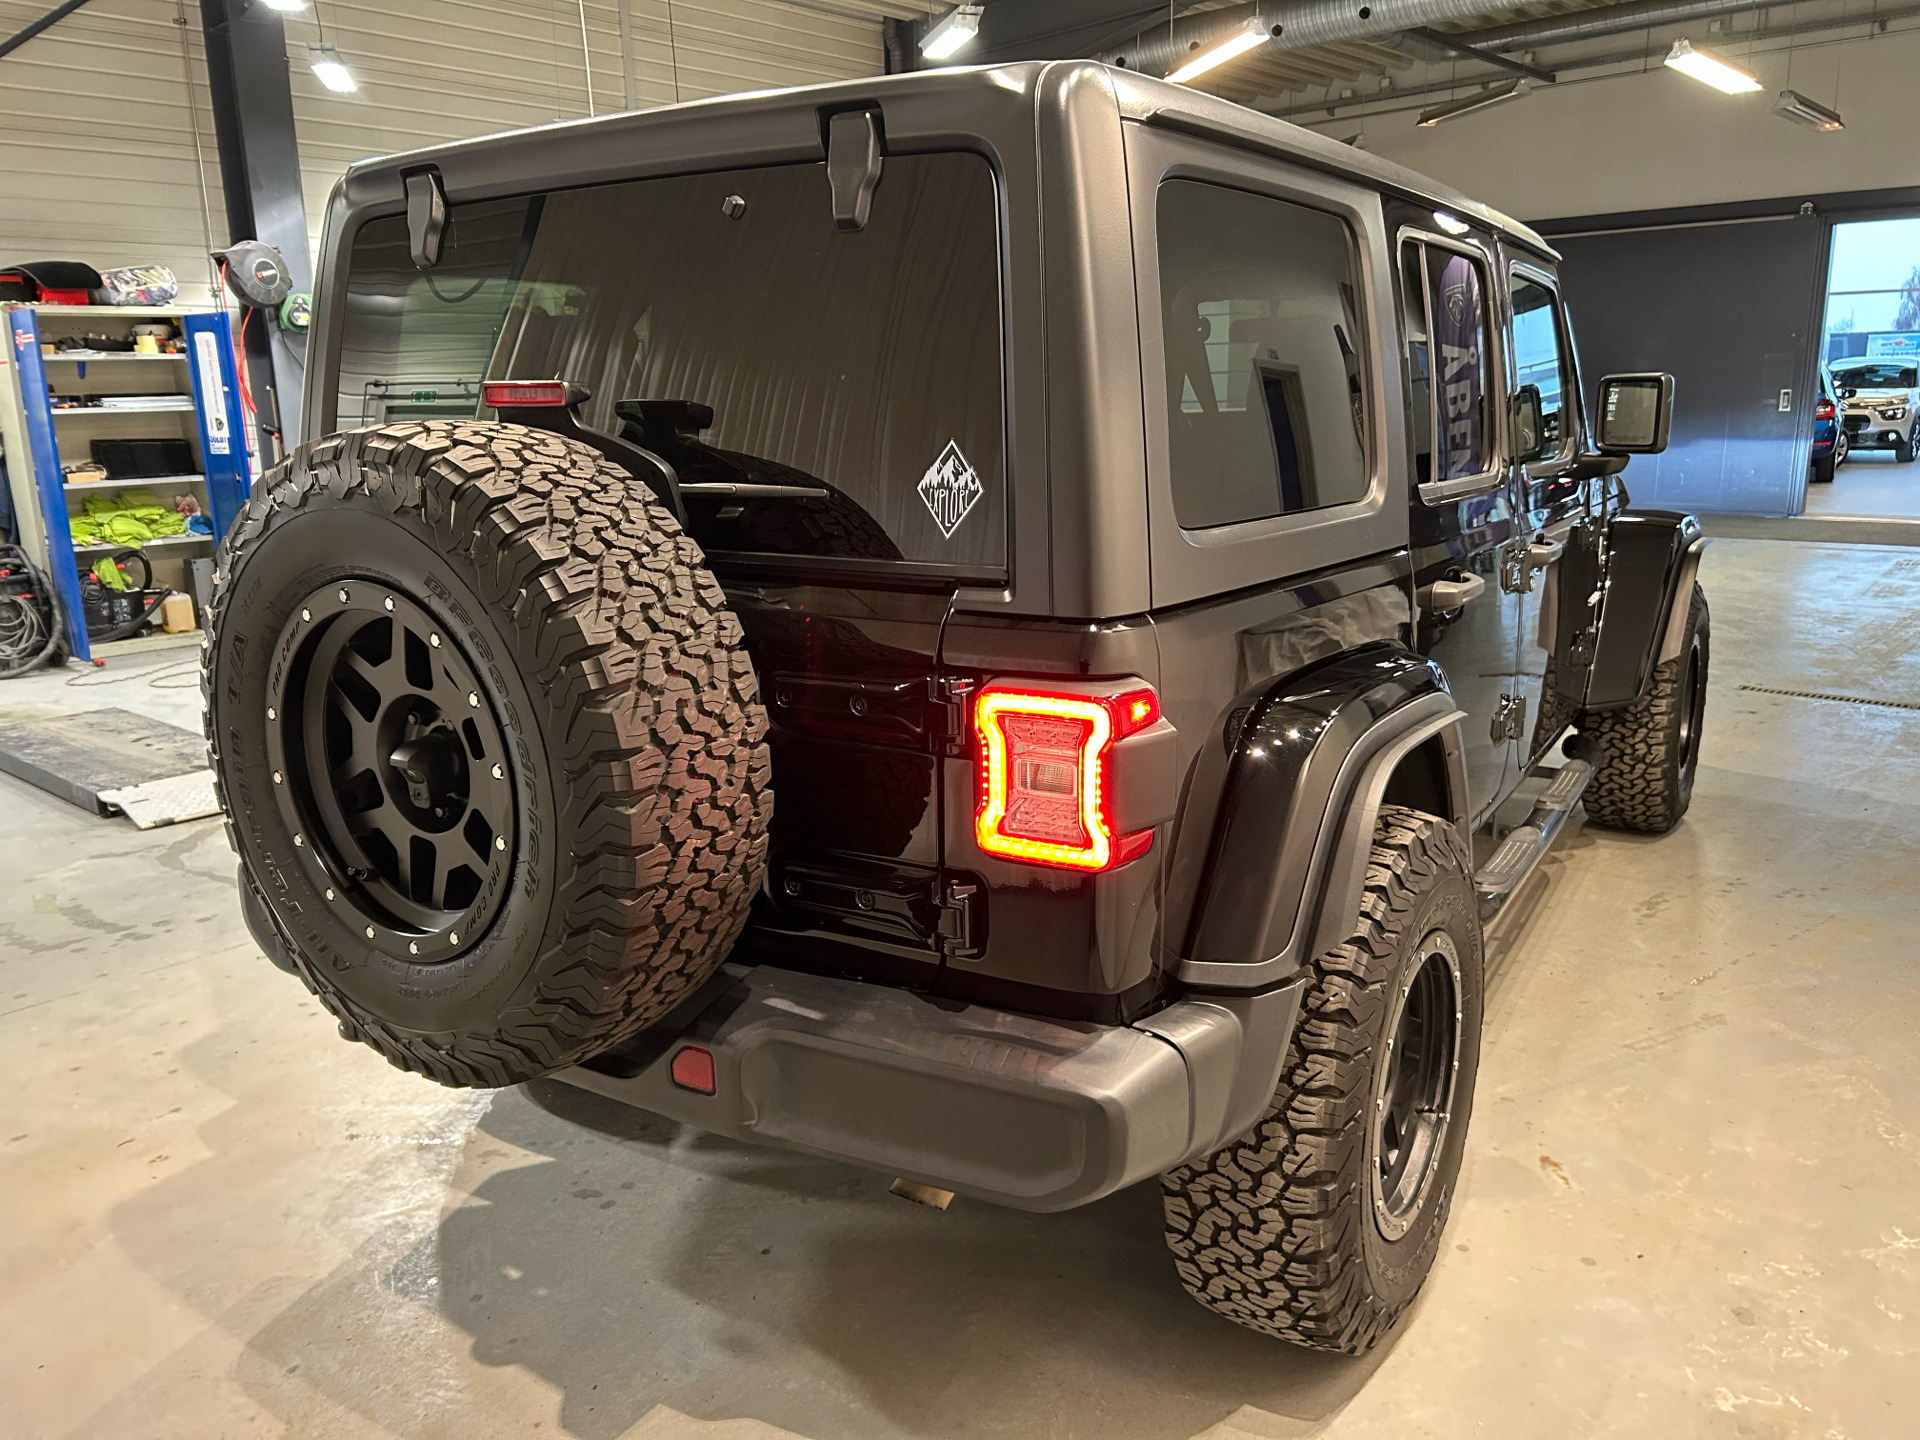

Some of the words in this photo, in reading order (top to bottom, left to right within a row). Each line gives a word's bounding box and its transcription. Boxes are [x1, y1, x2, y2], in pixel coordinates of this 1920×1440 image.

[929, 488, 969, 527] EXPLORE
[227, 631, 248, 704] T/A
[272, 662, 283, 697] PRO
[282, 621, 301, 660] COMP
[424, 571, 541, 902] BFGoodrich
